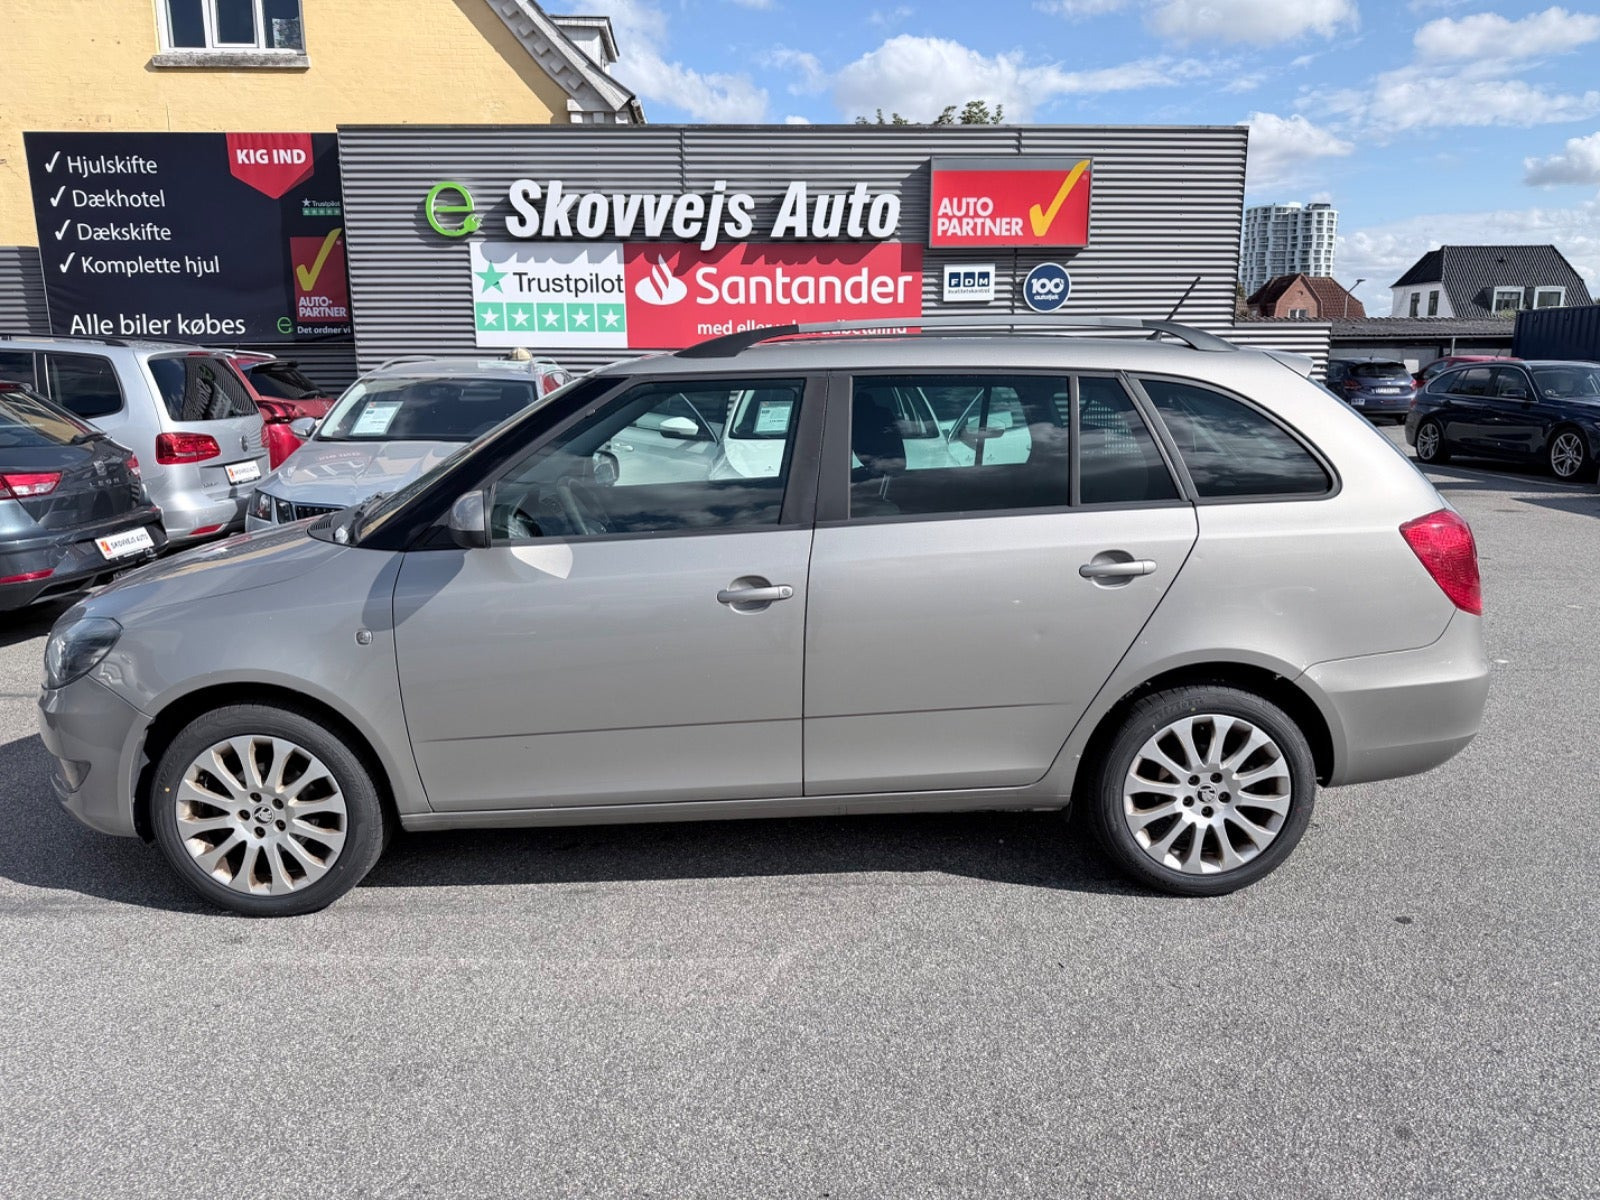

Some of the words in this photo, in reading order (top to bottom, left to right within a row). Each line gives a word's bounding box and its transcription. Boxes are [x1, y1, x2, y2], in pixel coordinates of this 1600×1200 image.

[67, 155, 158, 178] Hjulskifte
[236, 149, 269, 165] KIG
[272, 149, 306, 165] IND
[72, 189, 166, 208] Dækhotel
[938, 197, 994, 217] AUTO
[505, 179, 755, 251] Skovvejs
[771, 181, 901, 239] Auto
[77, 222, 172, 241] Dækskifte
[937, 217, 1024, 237] PARTNER
[81, 256, 181, 278] Komplette
[185, 255, 220, 278] hjul
[513, 271, 625, 299] Trustpilot
[696, 266, 913, 305] Santander
[298, 296, 333, 307] AUTO-
[298, 307, 347, 318] PARTNER
[70, 314, 114, 335] Alle
[120, 313, 172, 335] biler
[178, 313, 246, 335] købes
[297, 325, 312, 334] Det
[313, 325, 342, 334] ordner
[342, 325, 351, 334] vi
[697, 319, 733, 336] med
